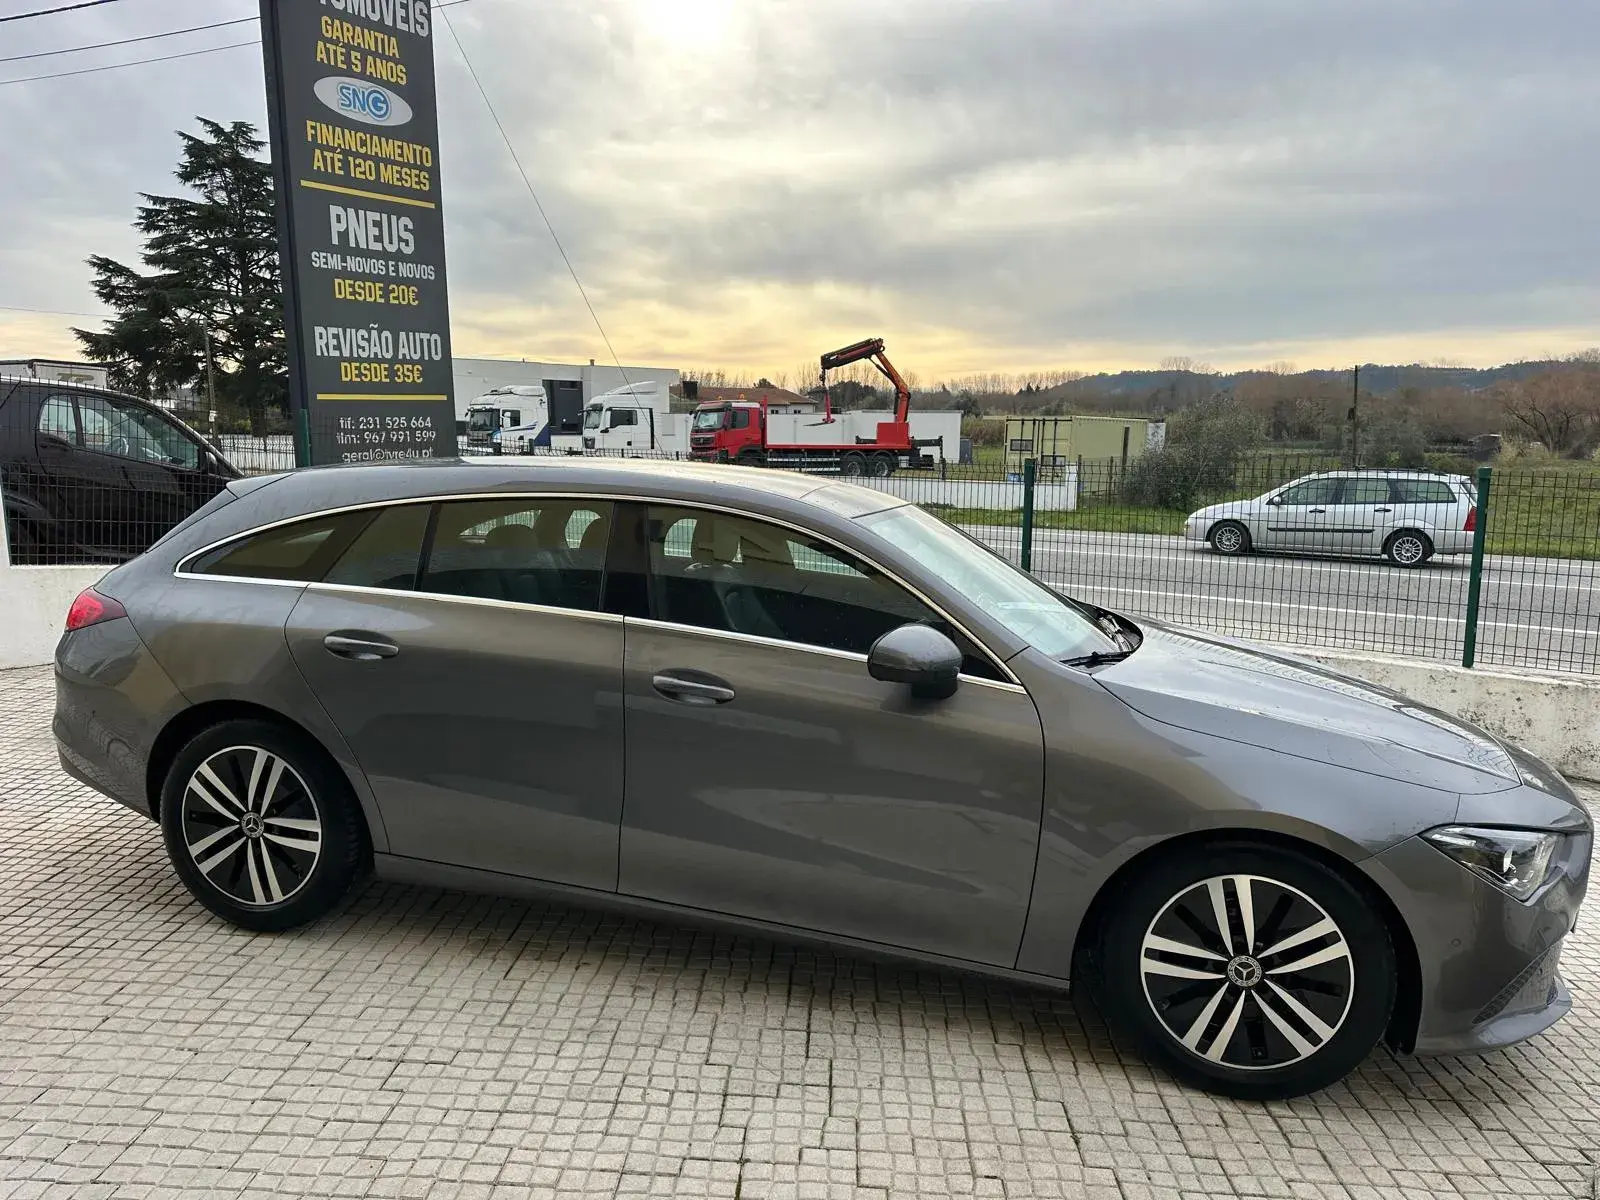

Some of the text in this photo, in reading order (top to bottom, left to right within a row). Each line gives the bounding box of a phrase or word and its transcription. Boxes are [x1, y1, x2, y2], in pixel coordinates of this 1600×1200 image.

[321, 16, 400, 58] GARANTIA
[316, 41, 408, 86] ATÉ 5 ANOS
[338, 83, 390, 120] SNG
[306, 120, 432, 168] FINANCIAMENTO
[313, 149, 430, 192] ATÉ 120 MESES
[329, 204, 415, 255] PNEUS
[311, 251, 435, 280] SEMI-NOVOS E NOVOS
[334, 278, 419, 306] DESDE 20€
[314, 323, 442, 361] REVISÃO AUTO
[340, 361, 423, 384] DESDE 35€
[359, 416, 380, 429] 231
[385, 416, 407, 429] 525
[410, 416, 432, 428] 664
[363, 431, 386, 443] 967
[390, 430, 410, 442] 991
[415, 429, 436, 442] 599
